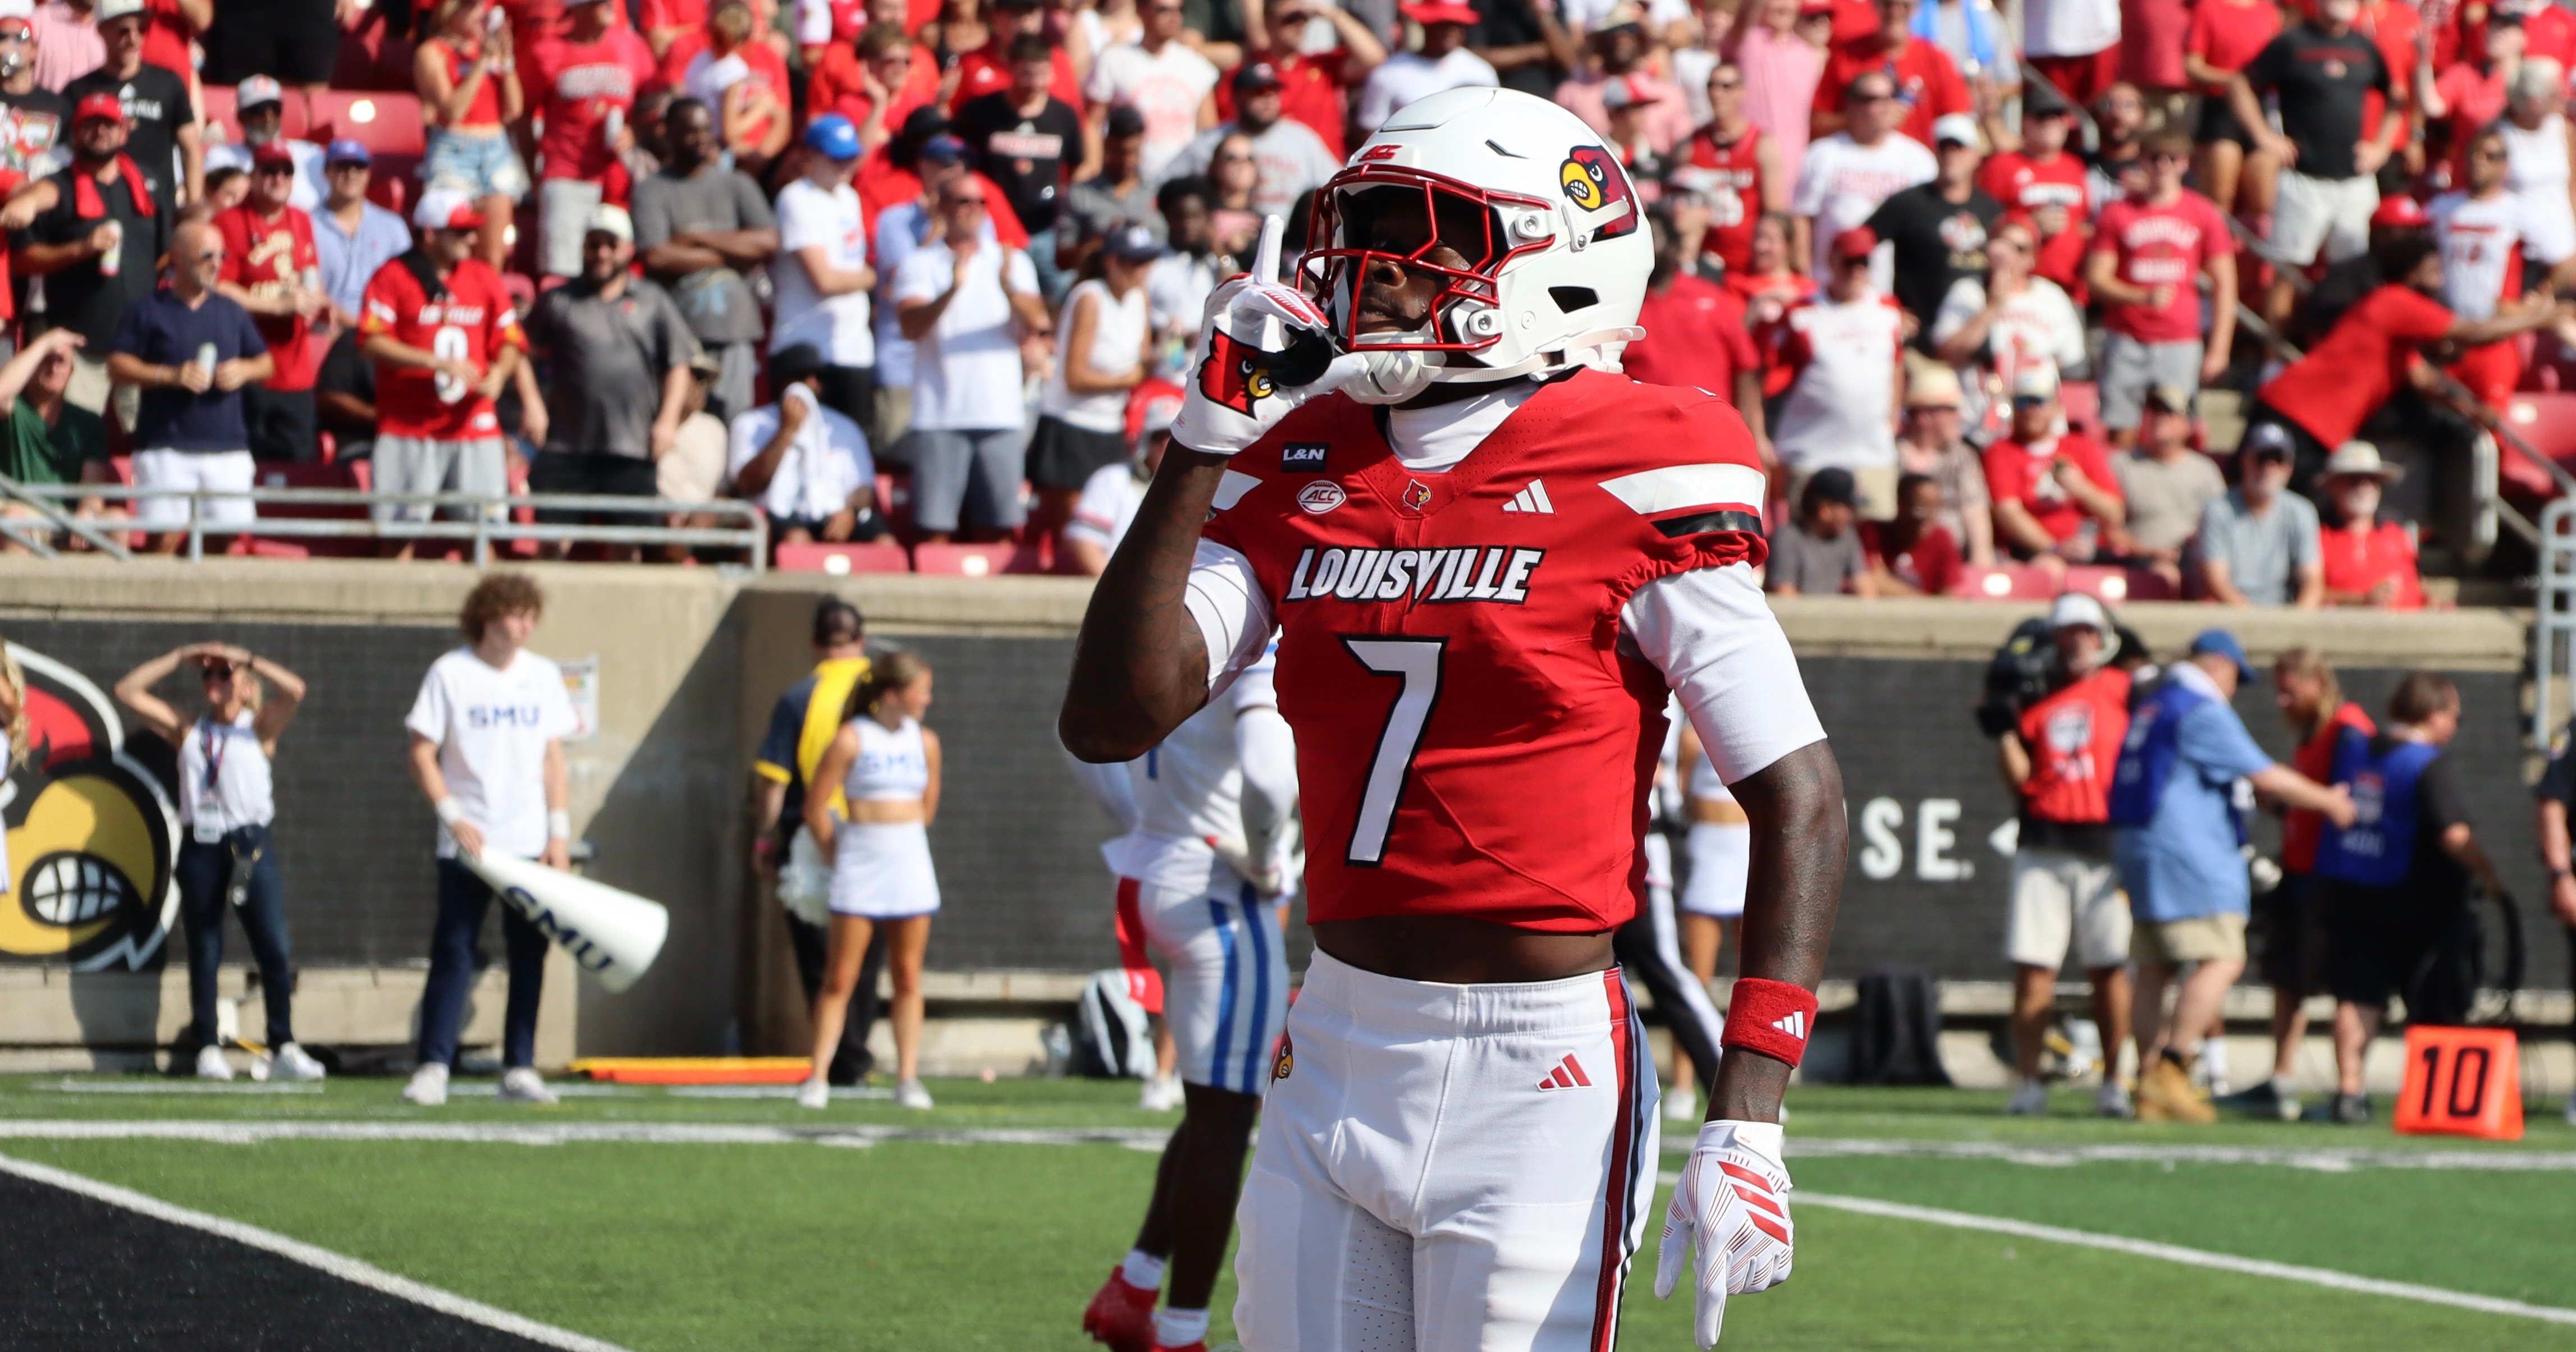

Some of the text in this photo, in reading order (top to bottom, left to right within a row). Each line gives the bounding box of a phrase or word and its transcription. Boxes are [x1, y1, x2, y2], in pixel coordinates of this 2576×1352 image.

[1283, 448, 1325, 461] L&N
[1305, 490, 1339, 501] ACC
[1284, 547, 1545, 604] LOUISVILLE
[469, 705, 540, 728] SMU
[1342, 638, 1447, 865] 7
[505, 886, 614, 971] SMU
[2422, 1046, 2490, 1117] 10
